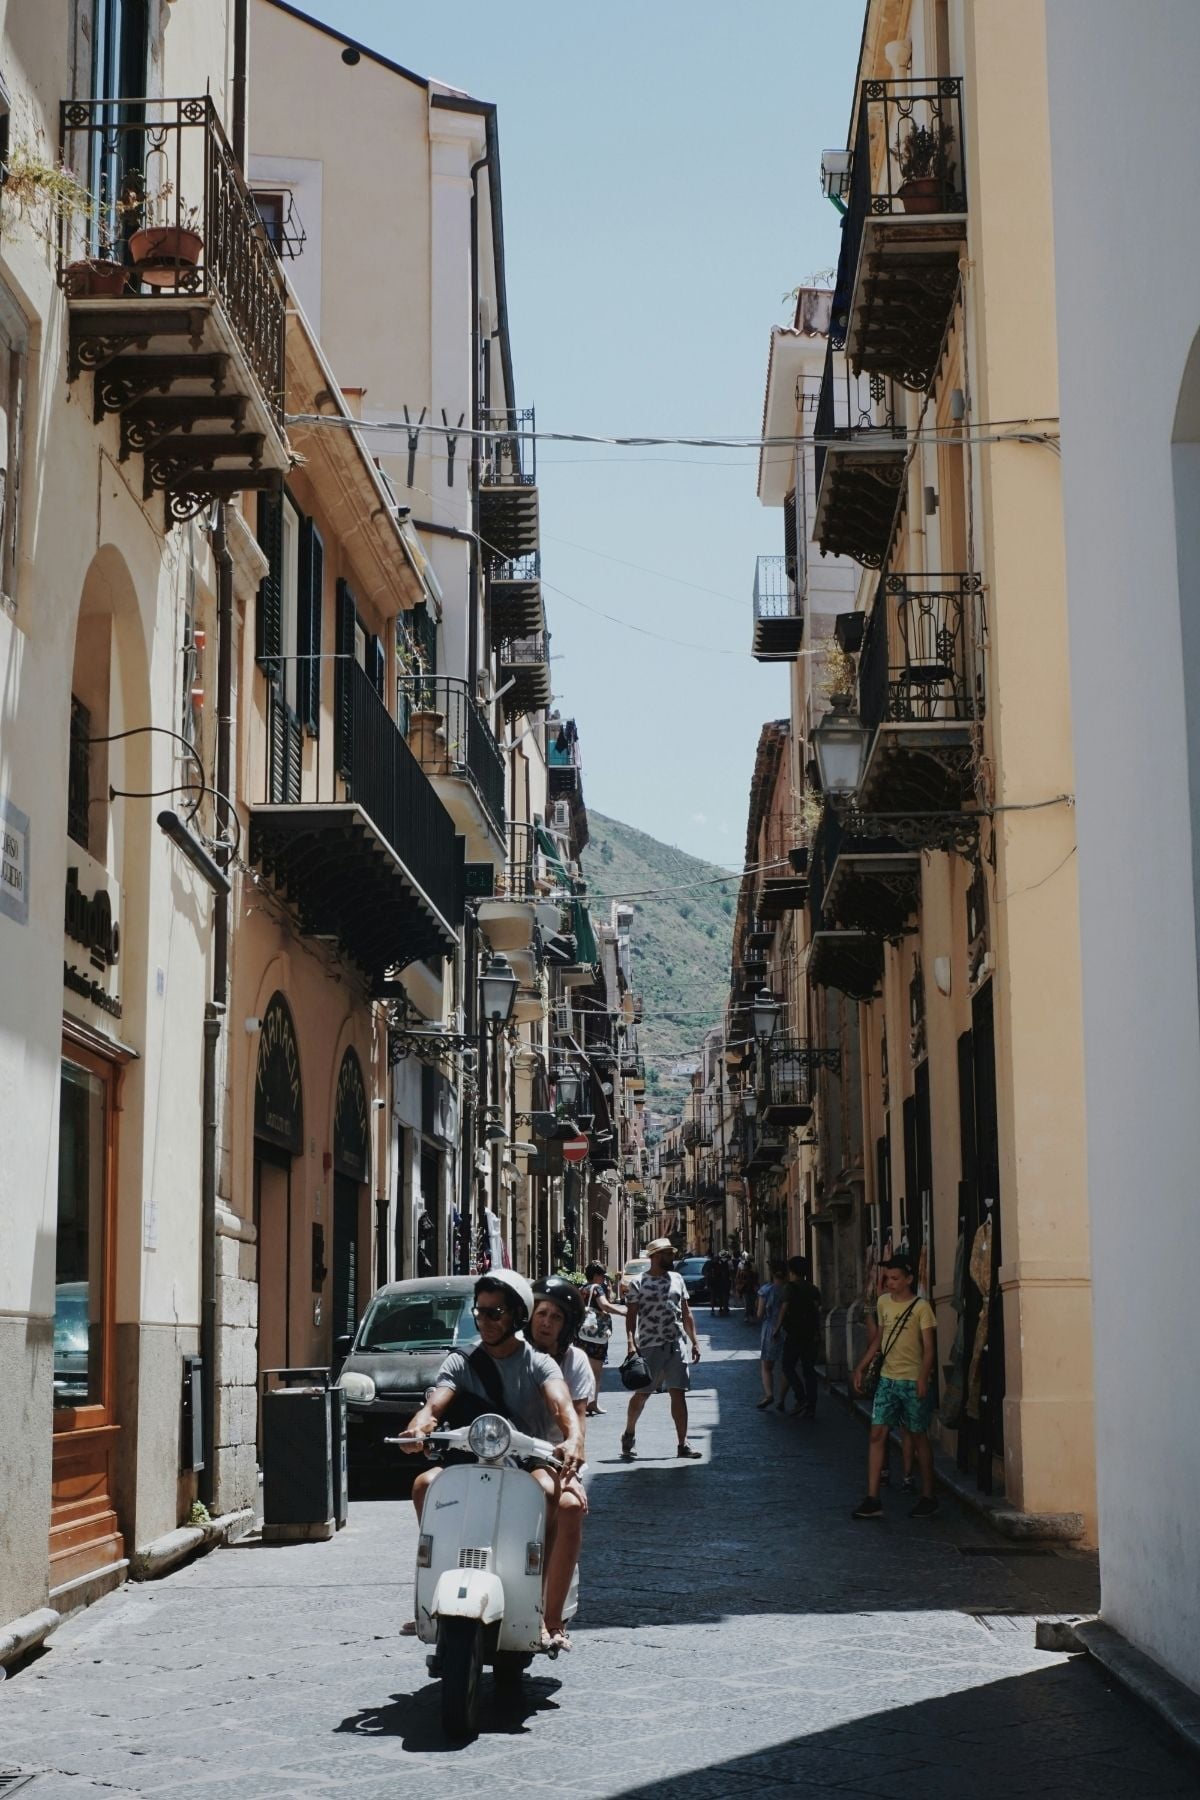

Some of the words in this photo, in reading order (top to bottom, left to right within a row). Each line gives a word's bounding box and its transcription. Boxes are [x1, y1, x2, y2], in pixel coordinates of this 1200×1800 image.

[1, 831, 19, 861] ORSO
[257, 1006, 299, 1110] FARMACIA
[336, 1059, 366, 1145] FARMACIA
